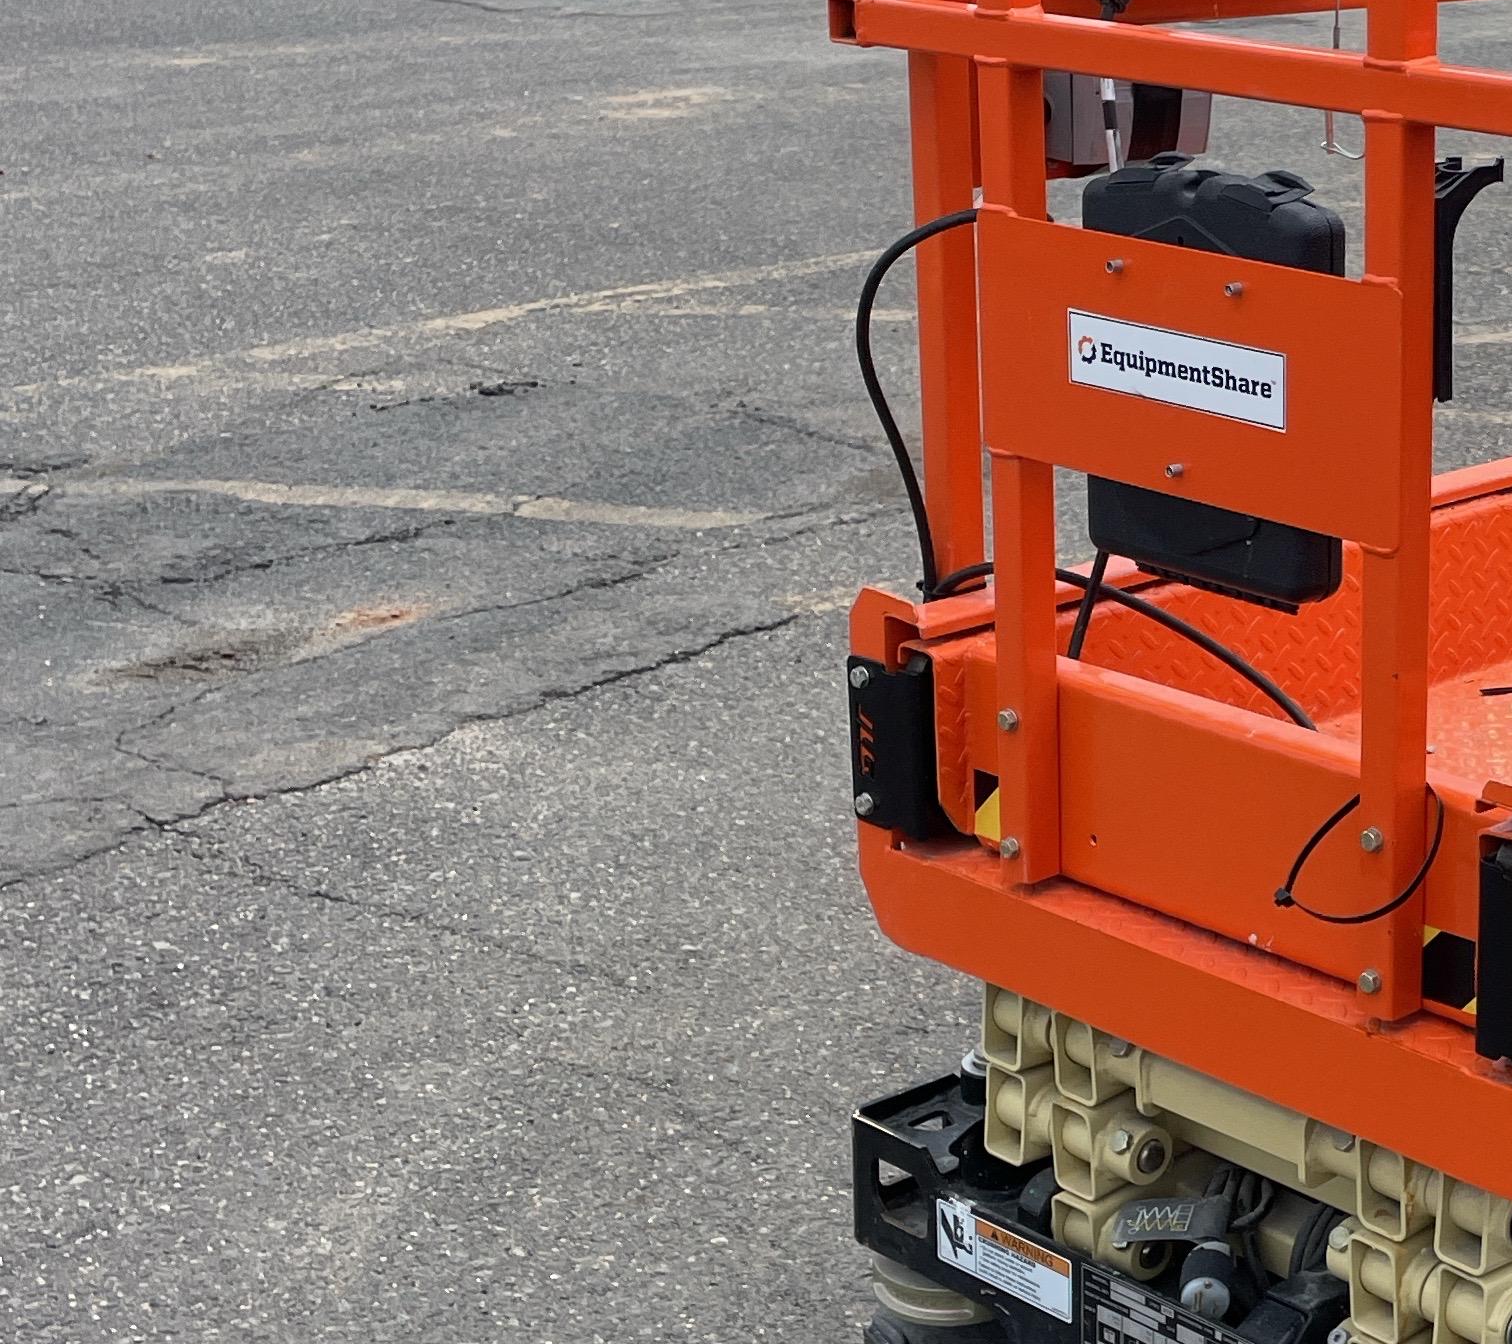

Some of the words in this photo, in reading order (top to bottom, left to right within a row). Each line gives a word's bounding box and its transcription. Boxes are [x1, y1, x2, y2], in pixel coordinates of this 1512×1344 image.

[1100, 342, 1273, 399] EquipmentShare
[856, 703, 876, 777] JLG
[1001, 1236, 1054, 1267] WARNING
